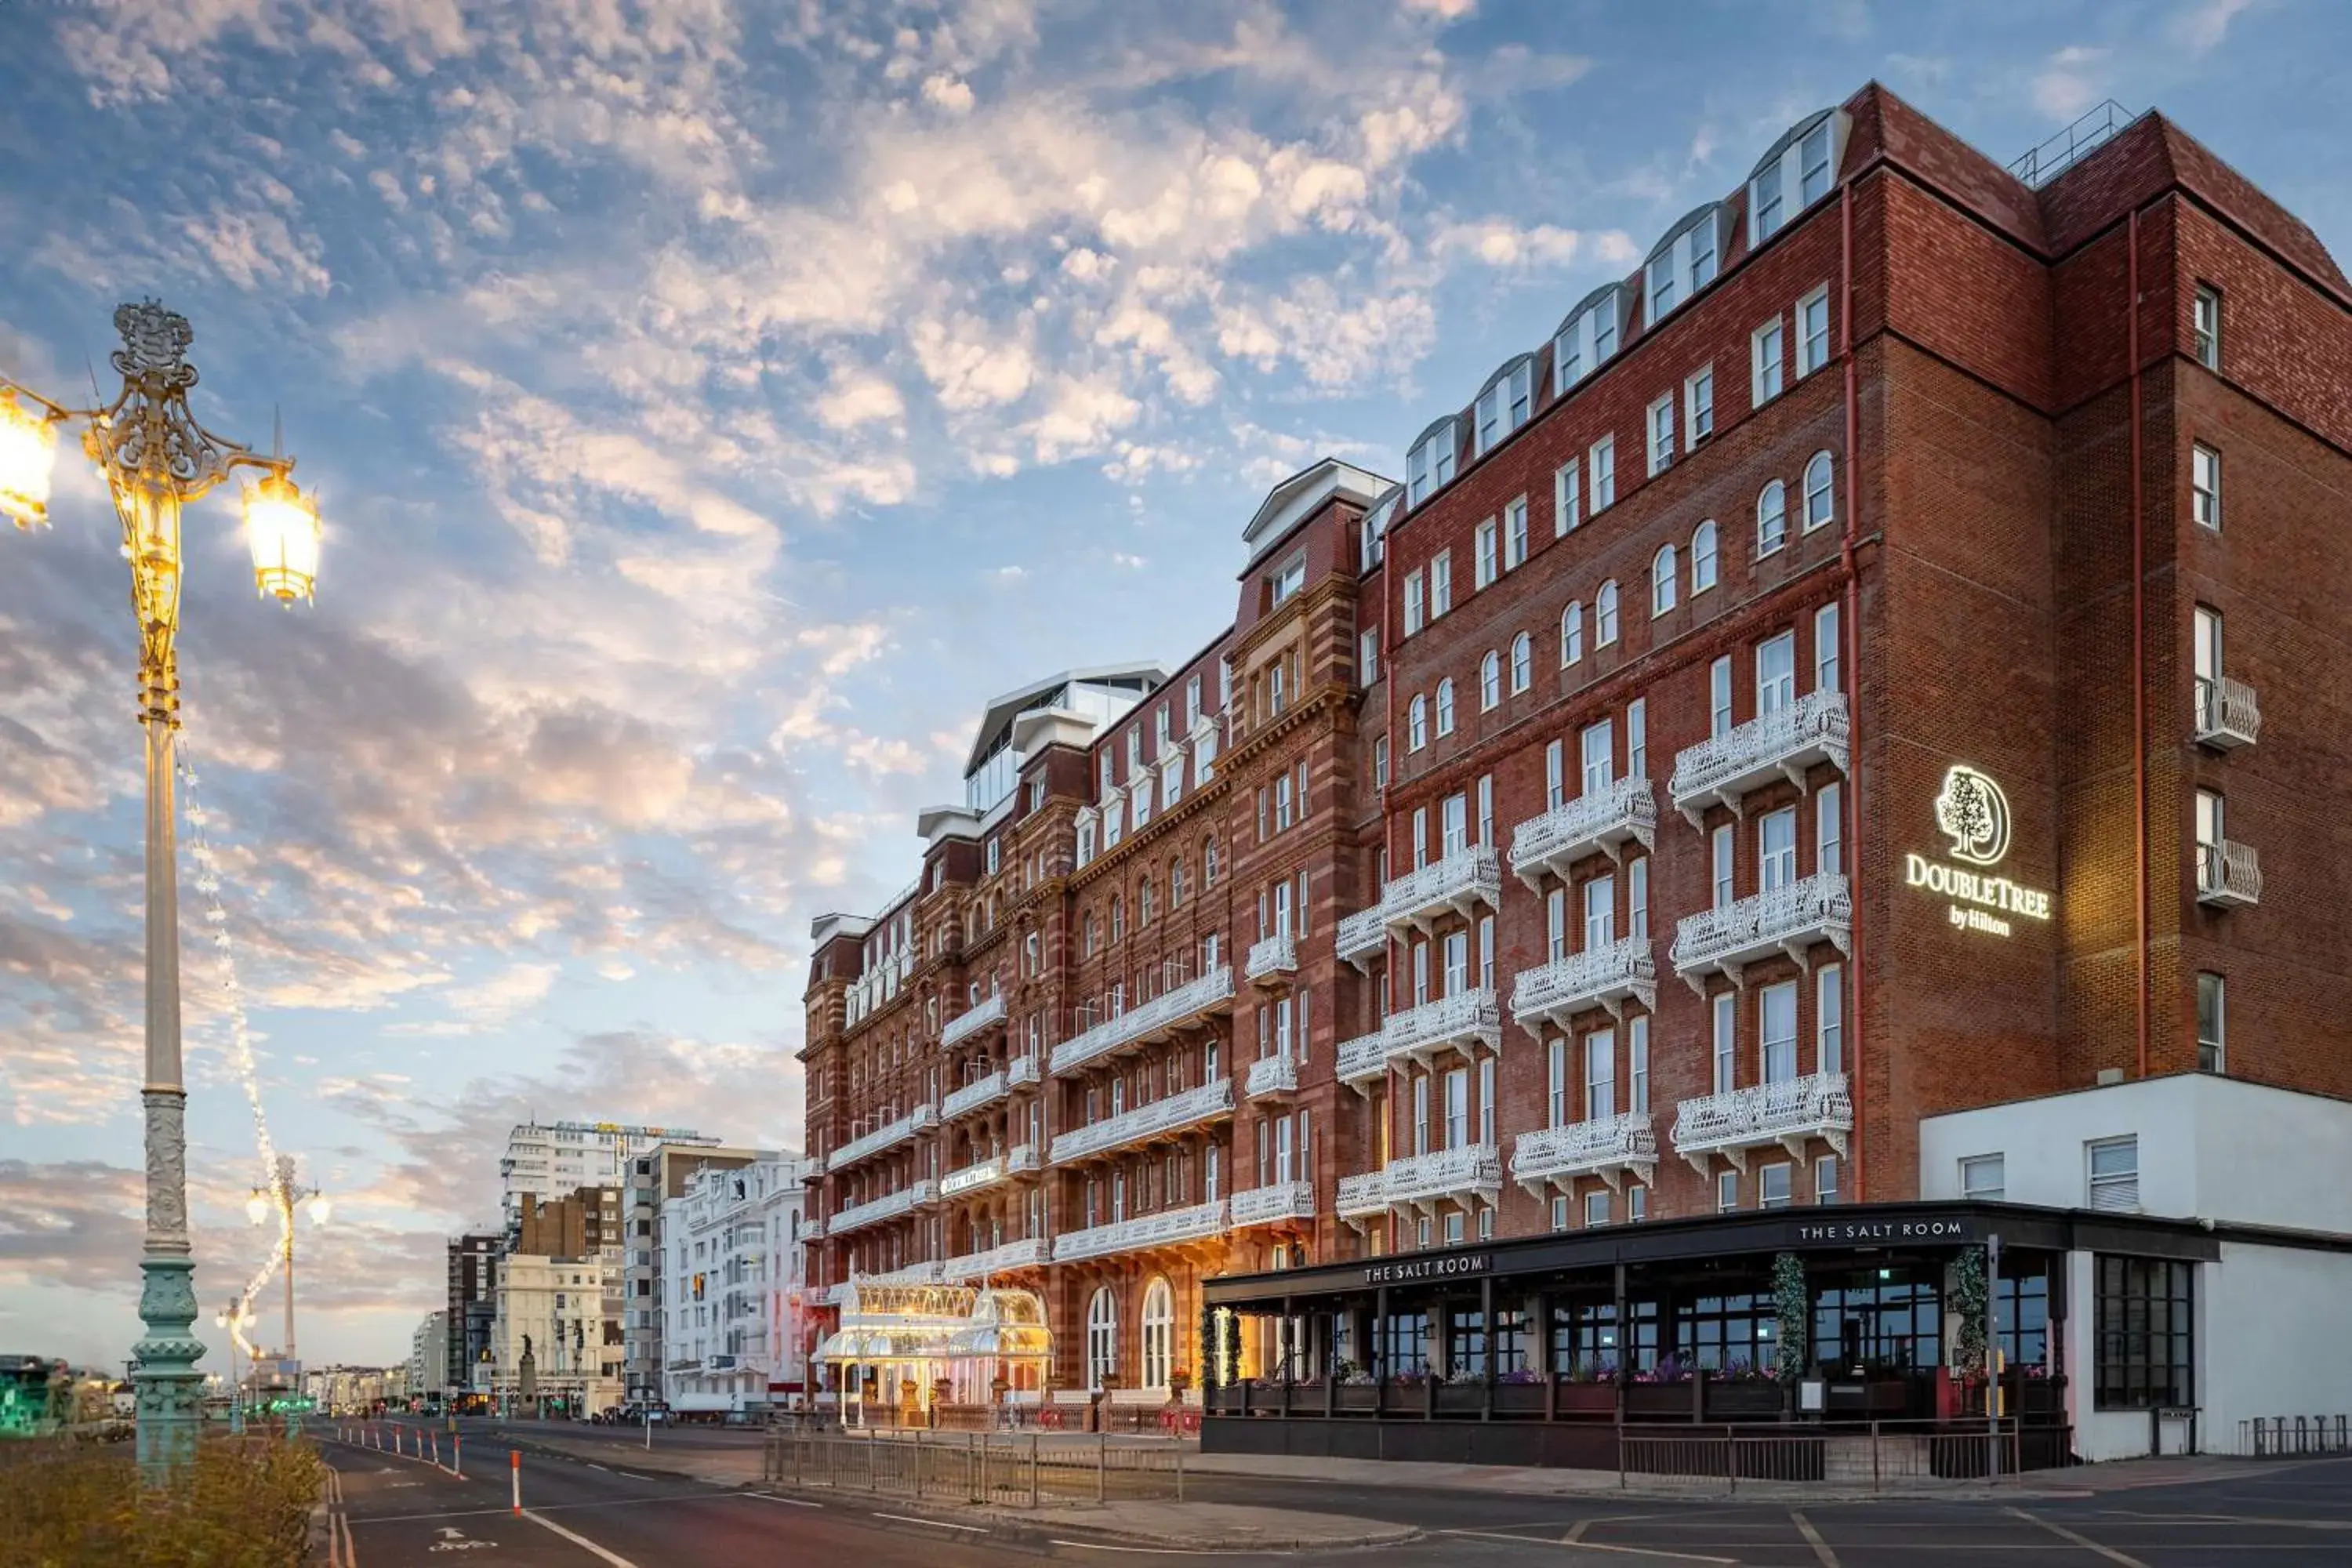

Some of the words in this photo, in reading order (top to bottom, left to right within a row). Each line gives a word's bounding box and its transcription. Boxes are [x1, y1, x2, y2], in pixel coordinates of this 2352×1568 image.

[1906, 853, 2051, 920] DOUBLETREE
[1949, 904, 1968, 930] by
[1968, 908, 2010, 937] Hilton
[1799, 1226, 1836, 1240] THE
[1846, 1224, 1893, 1239] SALT
[1902, 1221, 1961, 1236] ROOM
[1364, 1266, 1390, 1283] THE
[1397, 1261, 1431, 1279] SALT
[1436, 1255, 1483, 1274] ROOM
